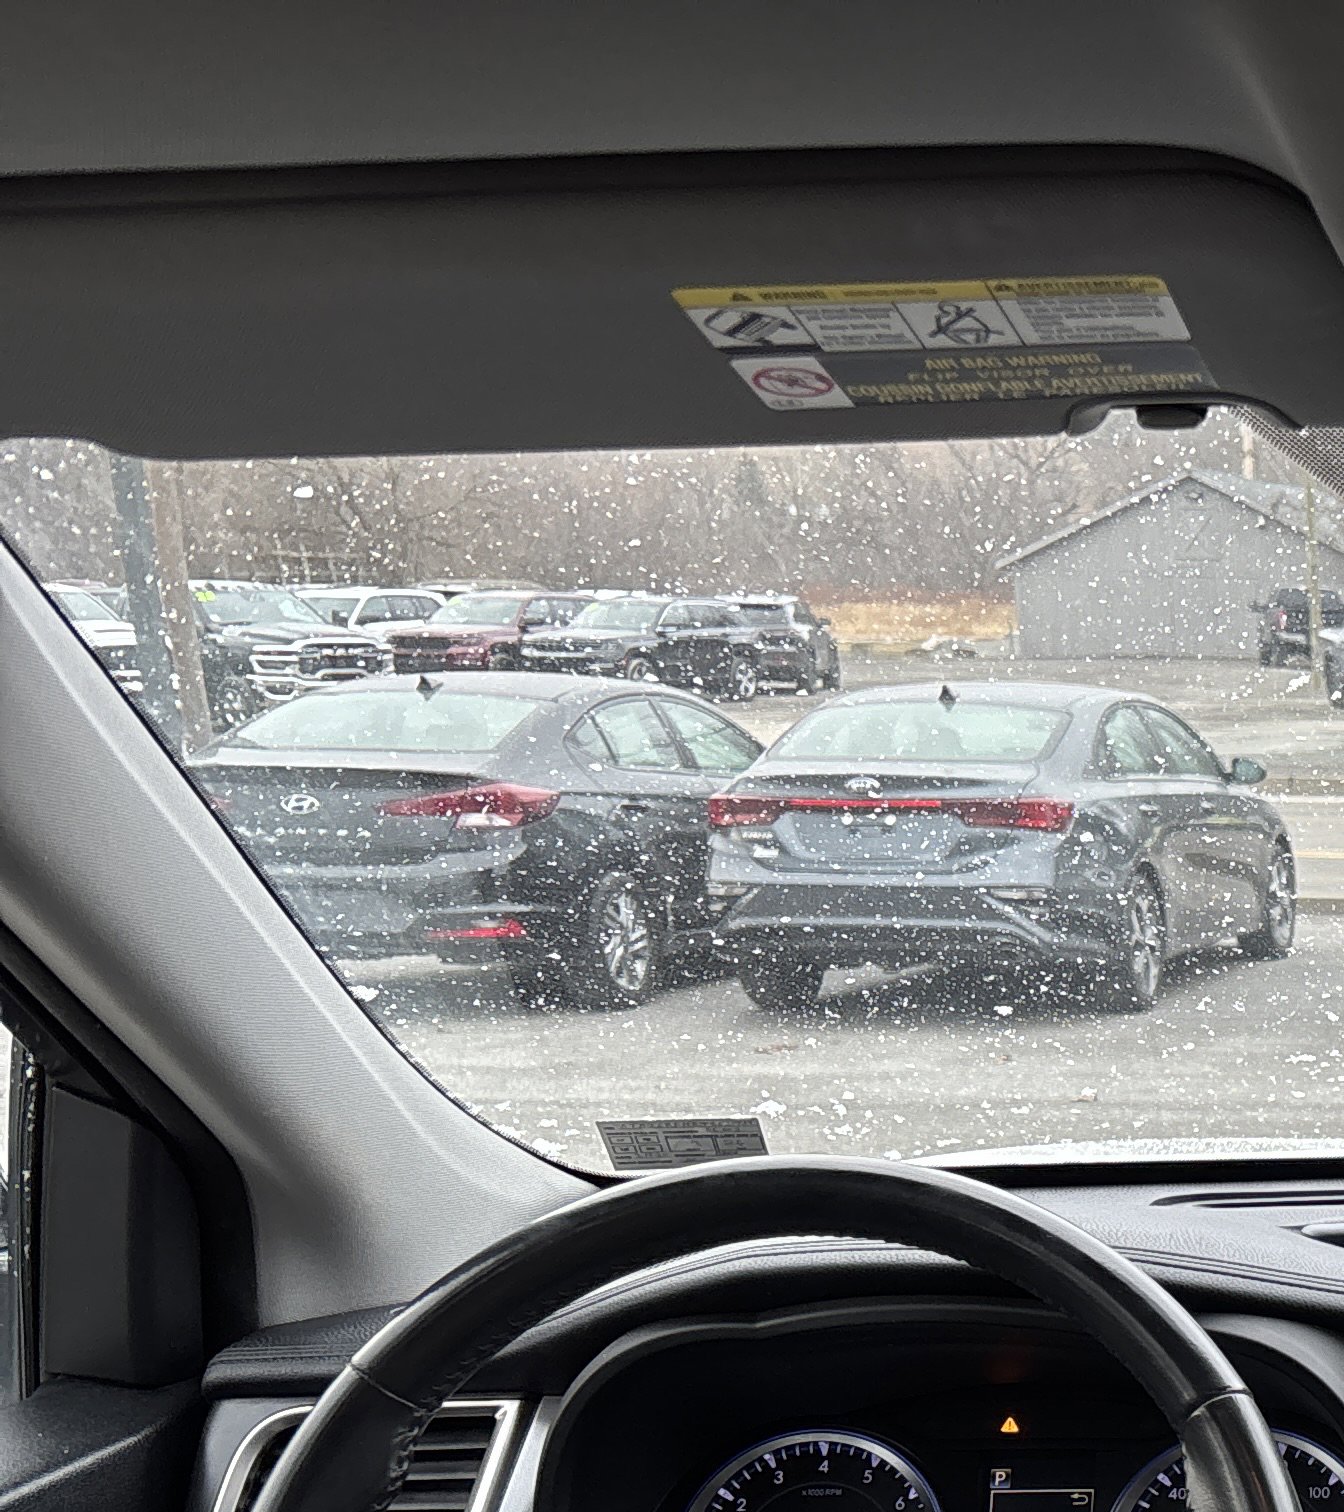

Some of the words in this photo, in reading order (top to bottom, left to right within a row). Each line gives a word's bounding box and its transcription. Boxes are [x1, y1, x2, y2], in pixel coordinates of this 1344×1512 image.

[925, 356, 958, 371] AIR
[960, 354, 1002, 369] BAG
[1005, 351, 1102, 367] WARNING
[1050, 372, 1203, 390] AVERTISSEMENT
[818, 1460, 829, 1473] 4
[773, 1470, 784, 1484] 3
[862, 1469, 873, 1484] 5
[994, 1472, 1006, 1485] P
[1168, 1487, 1188, 1501] 40
[1308, 1487, 1331, 1499] 100
[736, 1498, 747, 1512] 2
[895, 1496, 906, 1511] 6
